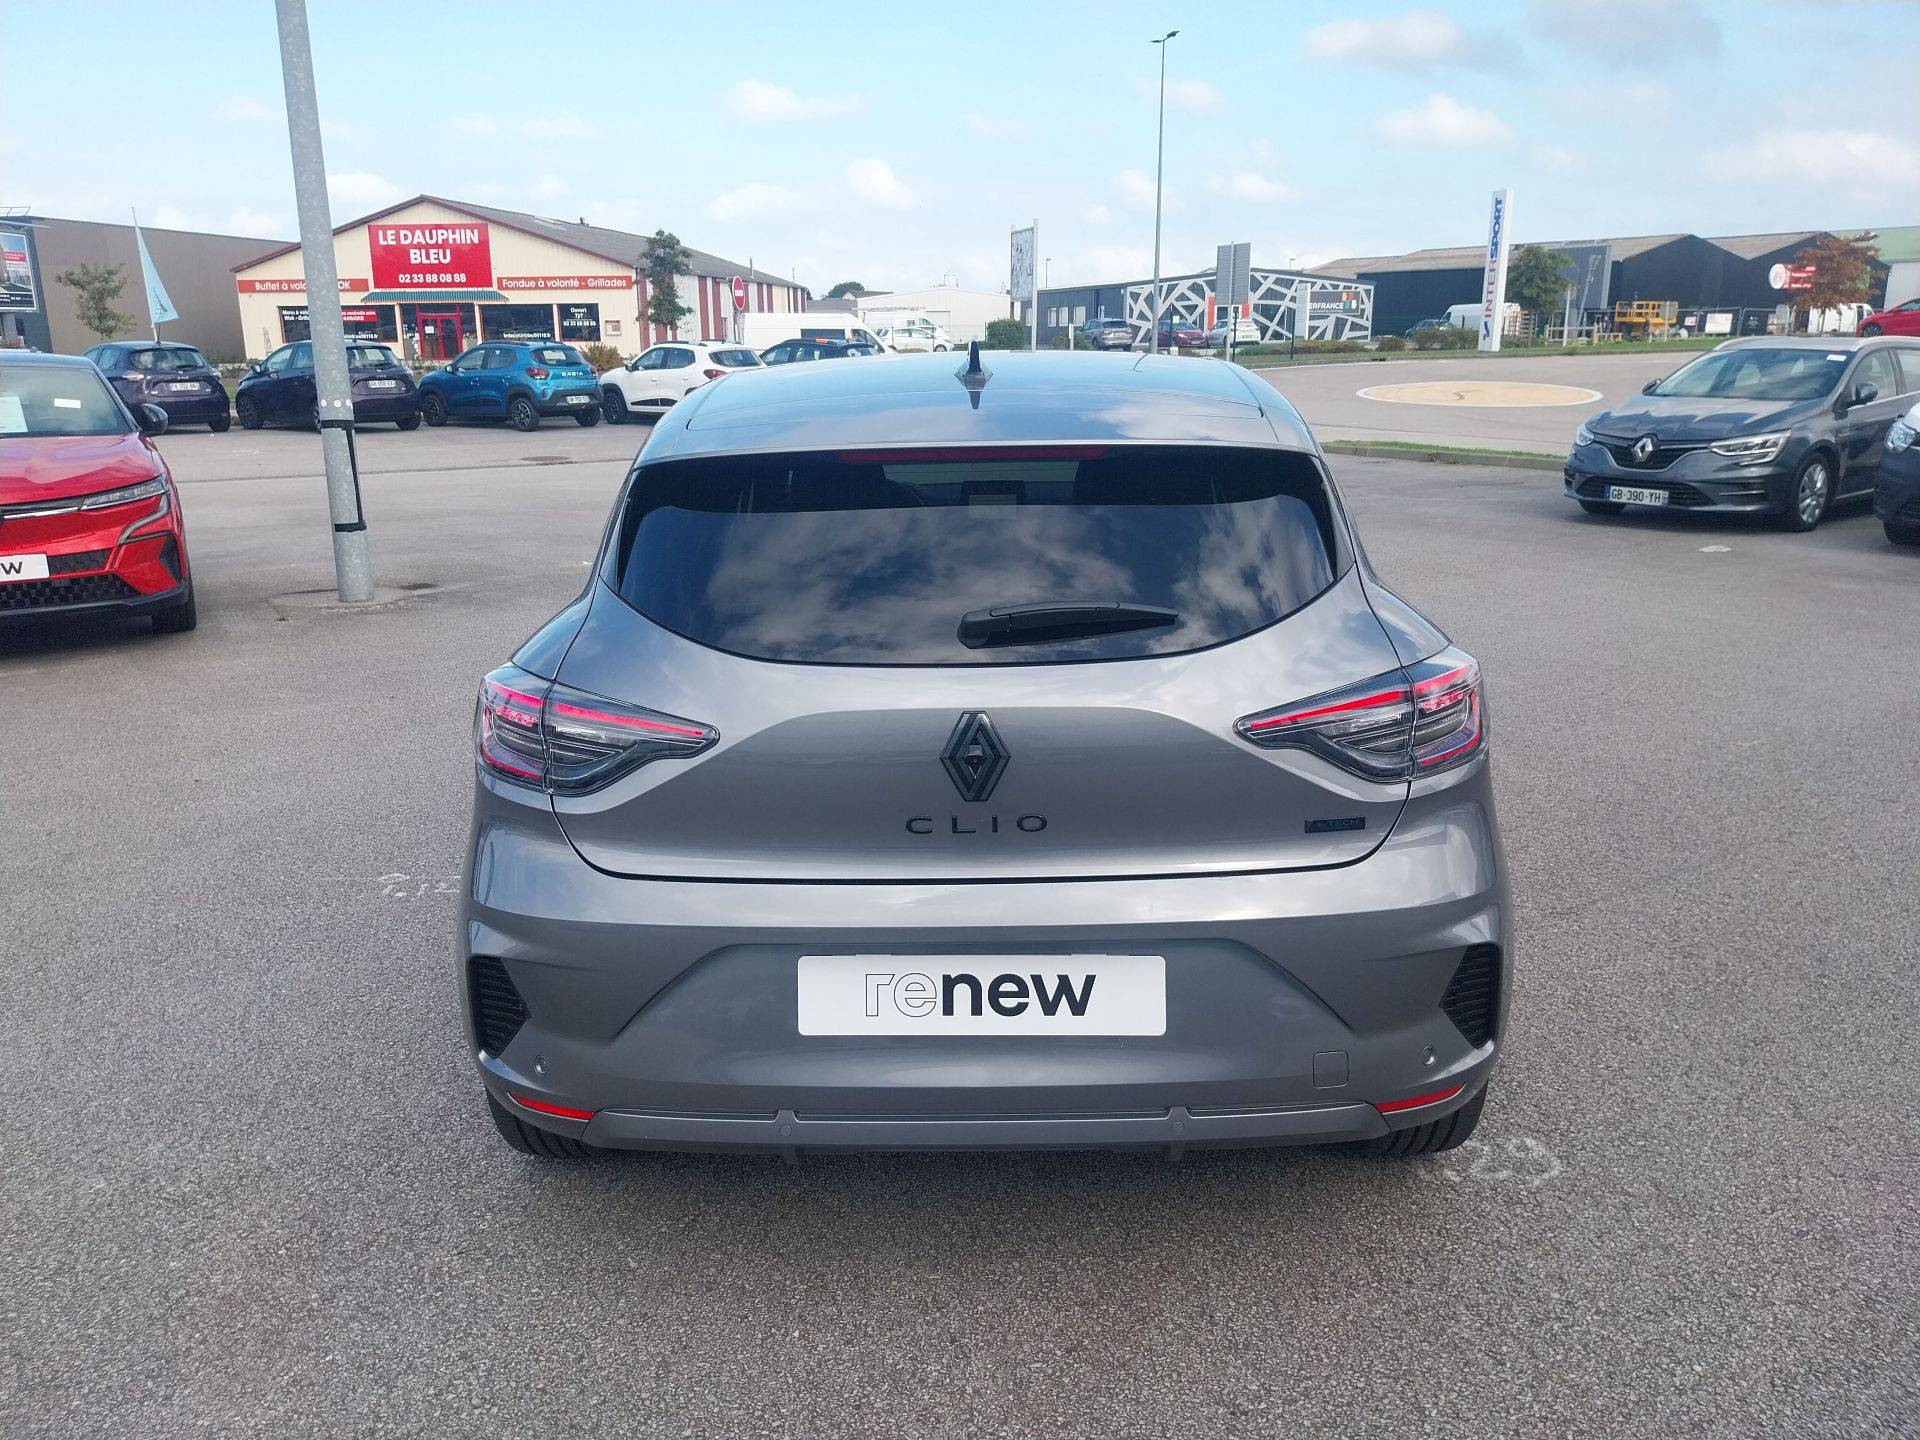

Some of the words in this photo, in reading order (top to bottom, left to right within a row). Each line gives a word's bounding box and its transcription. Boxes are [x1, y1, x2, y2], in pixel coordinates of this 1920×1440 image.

[378, 229, 397, 245] LE
[399, 228, 480, 245] DAUPHIN
[409, 248, 452, 264] BLEU
[1485, 197, 1503, 318] INTERSPORT
[255, 281, 281, 291] Buffet
[281, 281, 289, 291] à
[290, 281, 307, 291] volo
[338, 280, 352, 290] OK
[398, 273, 412, 283] 02
[412, 273, 425, 283] 33
[425, 273, 439, 283] 88
[439, 273, 453, 283] 08
[453, 273, 467, 283] 88
[502, 279, 536, 288] Fondue
[537, 278, 545, 288] à
[546, 277, 580, 288] volonté
[587, 277, 628, 288] Grillades
[1309, 302, 1344, 310] ERFRANCE
[1611, 488, 1662, 504] GB-390-YH
[0, 561, 23, 575] w
[905, 814, 1048, 834] CLIO
[865, 972, 1097, 1018] renew
